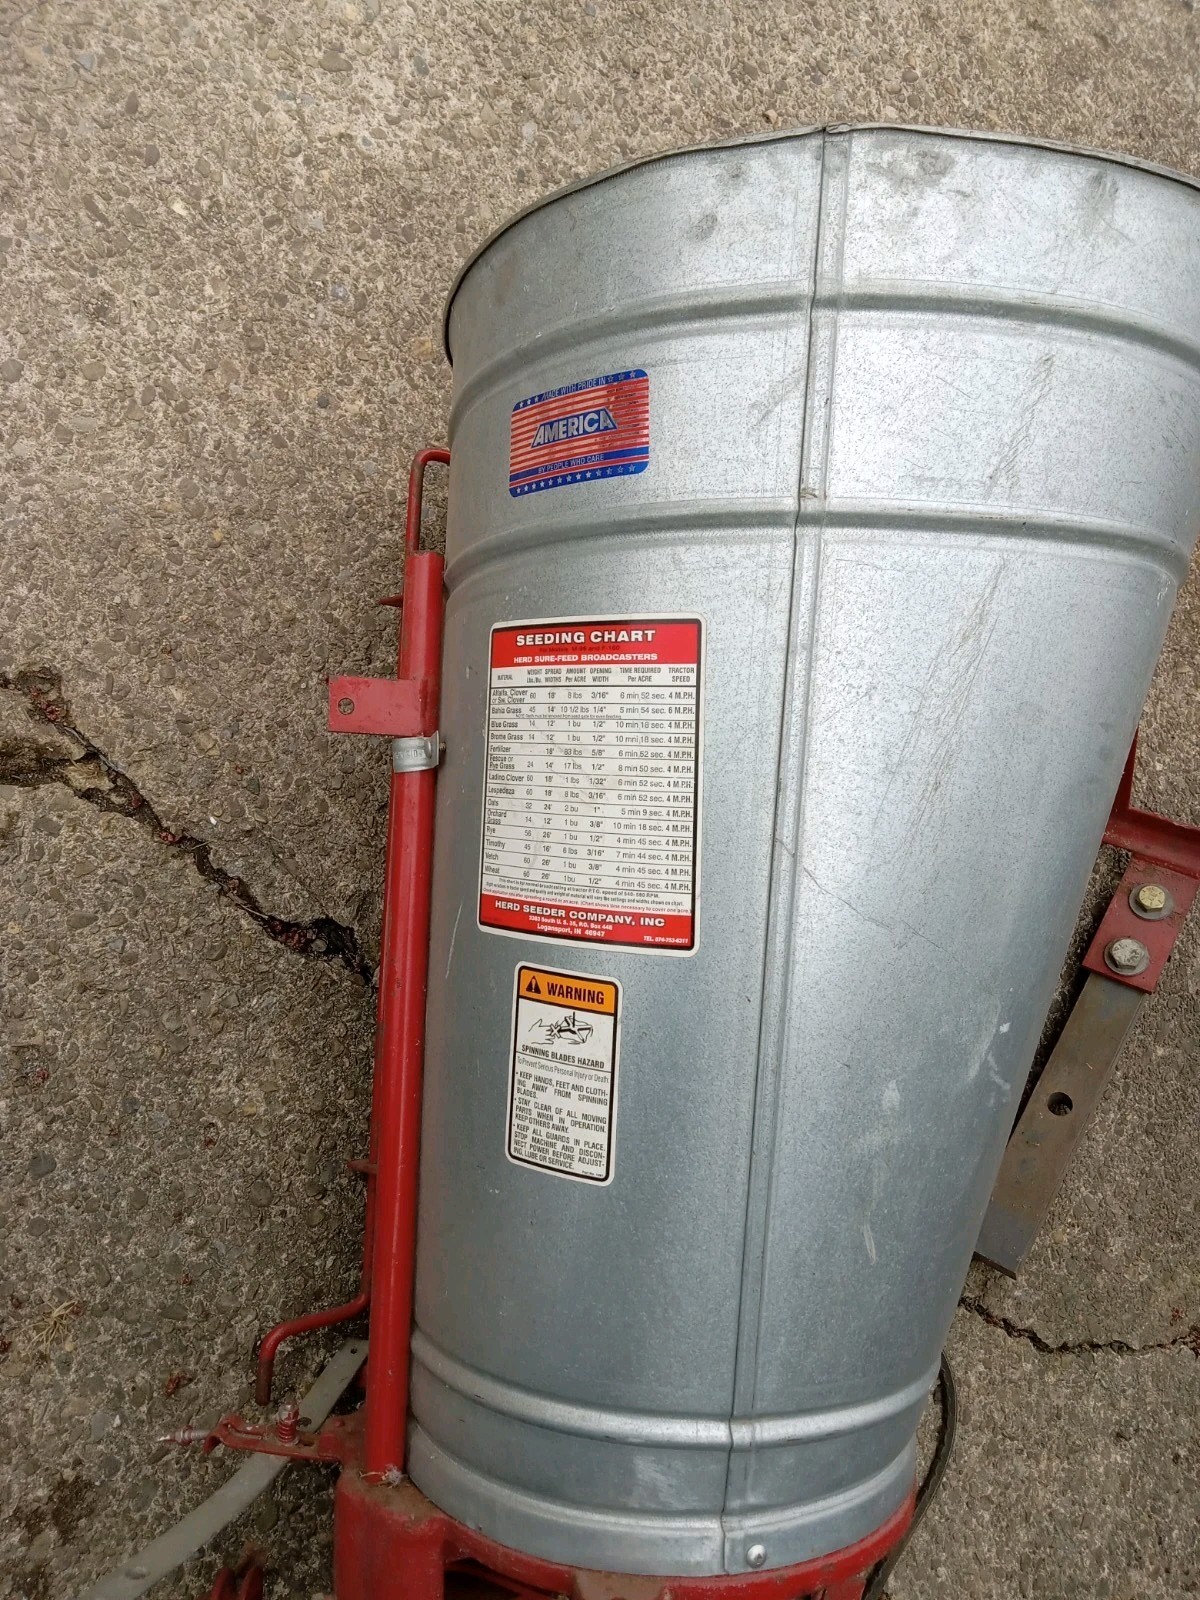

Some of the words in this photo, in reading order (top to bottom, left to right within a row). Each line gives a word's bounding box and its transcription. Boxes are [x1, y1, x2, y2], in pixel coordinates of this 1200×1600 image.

[542, 391, 559, 400] MADE
[560, 384, 576, 394] WITH
[578, 379, 597, 391] PRIDE
[599, 377, 606, 386] IN
[533, 409, 614, 447] AMERICA
[547, 462, 569, 472] PEOPLE
[570, 458, 586, 466] WHO
[587, 454, 604, 463] CARE
[517, 632, 584, 646] SEEDING
[590, 630, 655, 642] CHART
[581, 653, 658, 662] BROADCASTERS
[488, 786, 514, 795] Lespedeza
[486, 839, 505, 849] Timothy
[495, 900, 520, 911] HERD
[523, 905, 565, 917] SEEDER
[569, 911, 635, 925] COMPANY,
[640, 917, 665, 926] INC
[537, 924, 572, 934] Logansport,
[547, 982, 604, 1005] WARNING
[522, 1044, 549, 1057] SPINNING
[551, 1052, 575, 1064] BLADES
[578, 1057, 604, 1068] HAZARD
[522, 1057, 537, 1067] Prevent
[538, 1062, 553, 1072] Serious
[554, 1066, 573, 1077] Personal
[574, 1070, 587, 1081] Injury
[517, 1079, 526, 1087] ING
[532, 1083, 547, 1092] AWAY
[554, 1089, 571, 1099] FROM
[578, 1094, 608, 1106] SPINNING
[517, 1087, 538, 1099] BLADES.
[520, 1071, 532, 1080] KEEP
[534, 1075, 554, 1086] HANDS,
[556, 1080, 570, 1088] FEET
[571, 1082, 584, 1092] AND
[586, 1087, 608, 1097] CLOTH-
[515, 1113, 528, 1122] KEEP
[529, 1117, 550, 1129] OTHERS
[516, 1105, 532, 1115] PARTS
[537, 1111, 553, 1121] WHEN
[571, 1120, 606, 1133] OPERATION.
[518, 1097, 530, 1106] STAY
[534, 1102, 552, 1112] CLEAR
[567, 1110, 577, 1118] ALL
[582, 1113, 606, 1124] MOVING
[515, 1131, 527, 1140] STOP
[532, 1136, 557, 1149] MACHINE
[562, 1144, 574, 1153] AND
[580, 1149, 605, 1160] DISCON-
[517, 1124, 529, 1133] KEEP
[532, 1128, 542, 1137] ALL
[546, 1132, 570, 1144] GUARDS
[584, 1141, 606, 1151] PLACE.
[514, 1138, 527, 1148] NECT
[530, 1144, 549, 1155] POWER
[552, 1150, 575, 1162] BEFORE
[578, 1156, 604, 1168] ADJUST-
[525, 1150, 538, 1160] LUBE
[548, 1157, 574, 1170] SERVICE.
